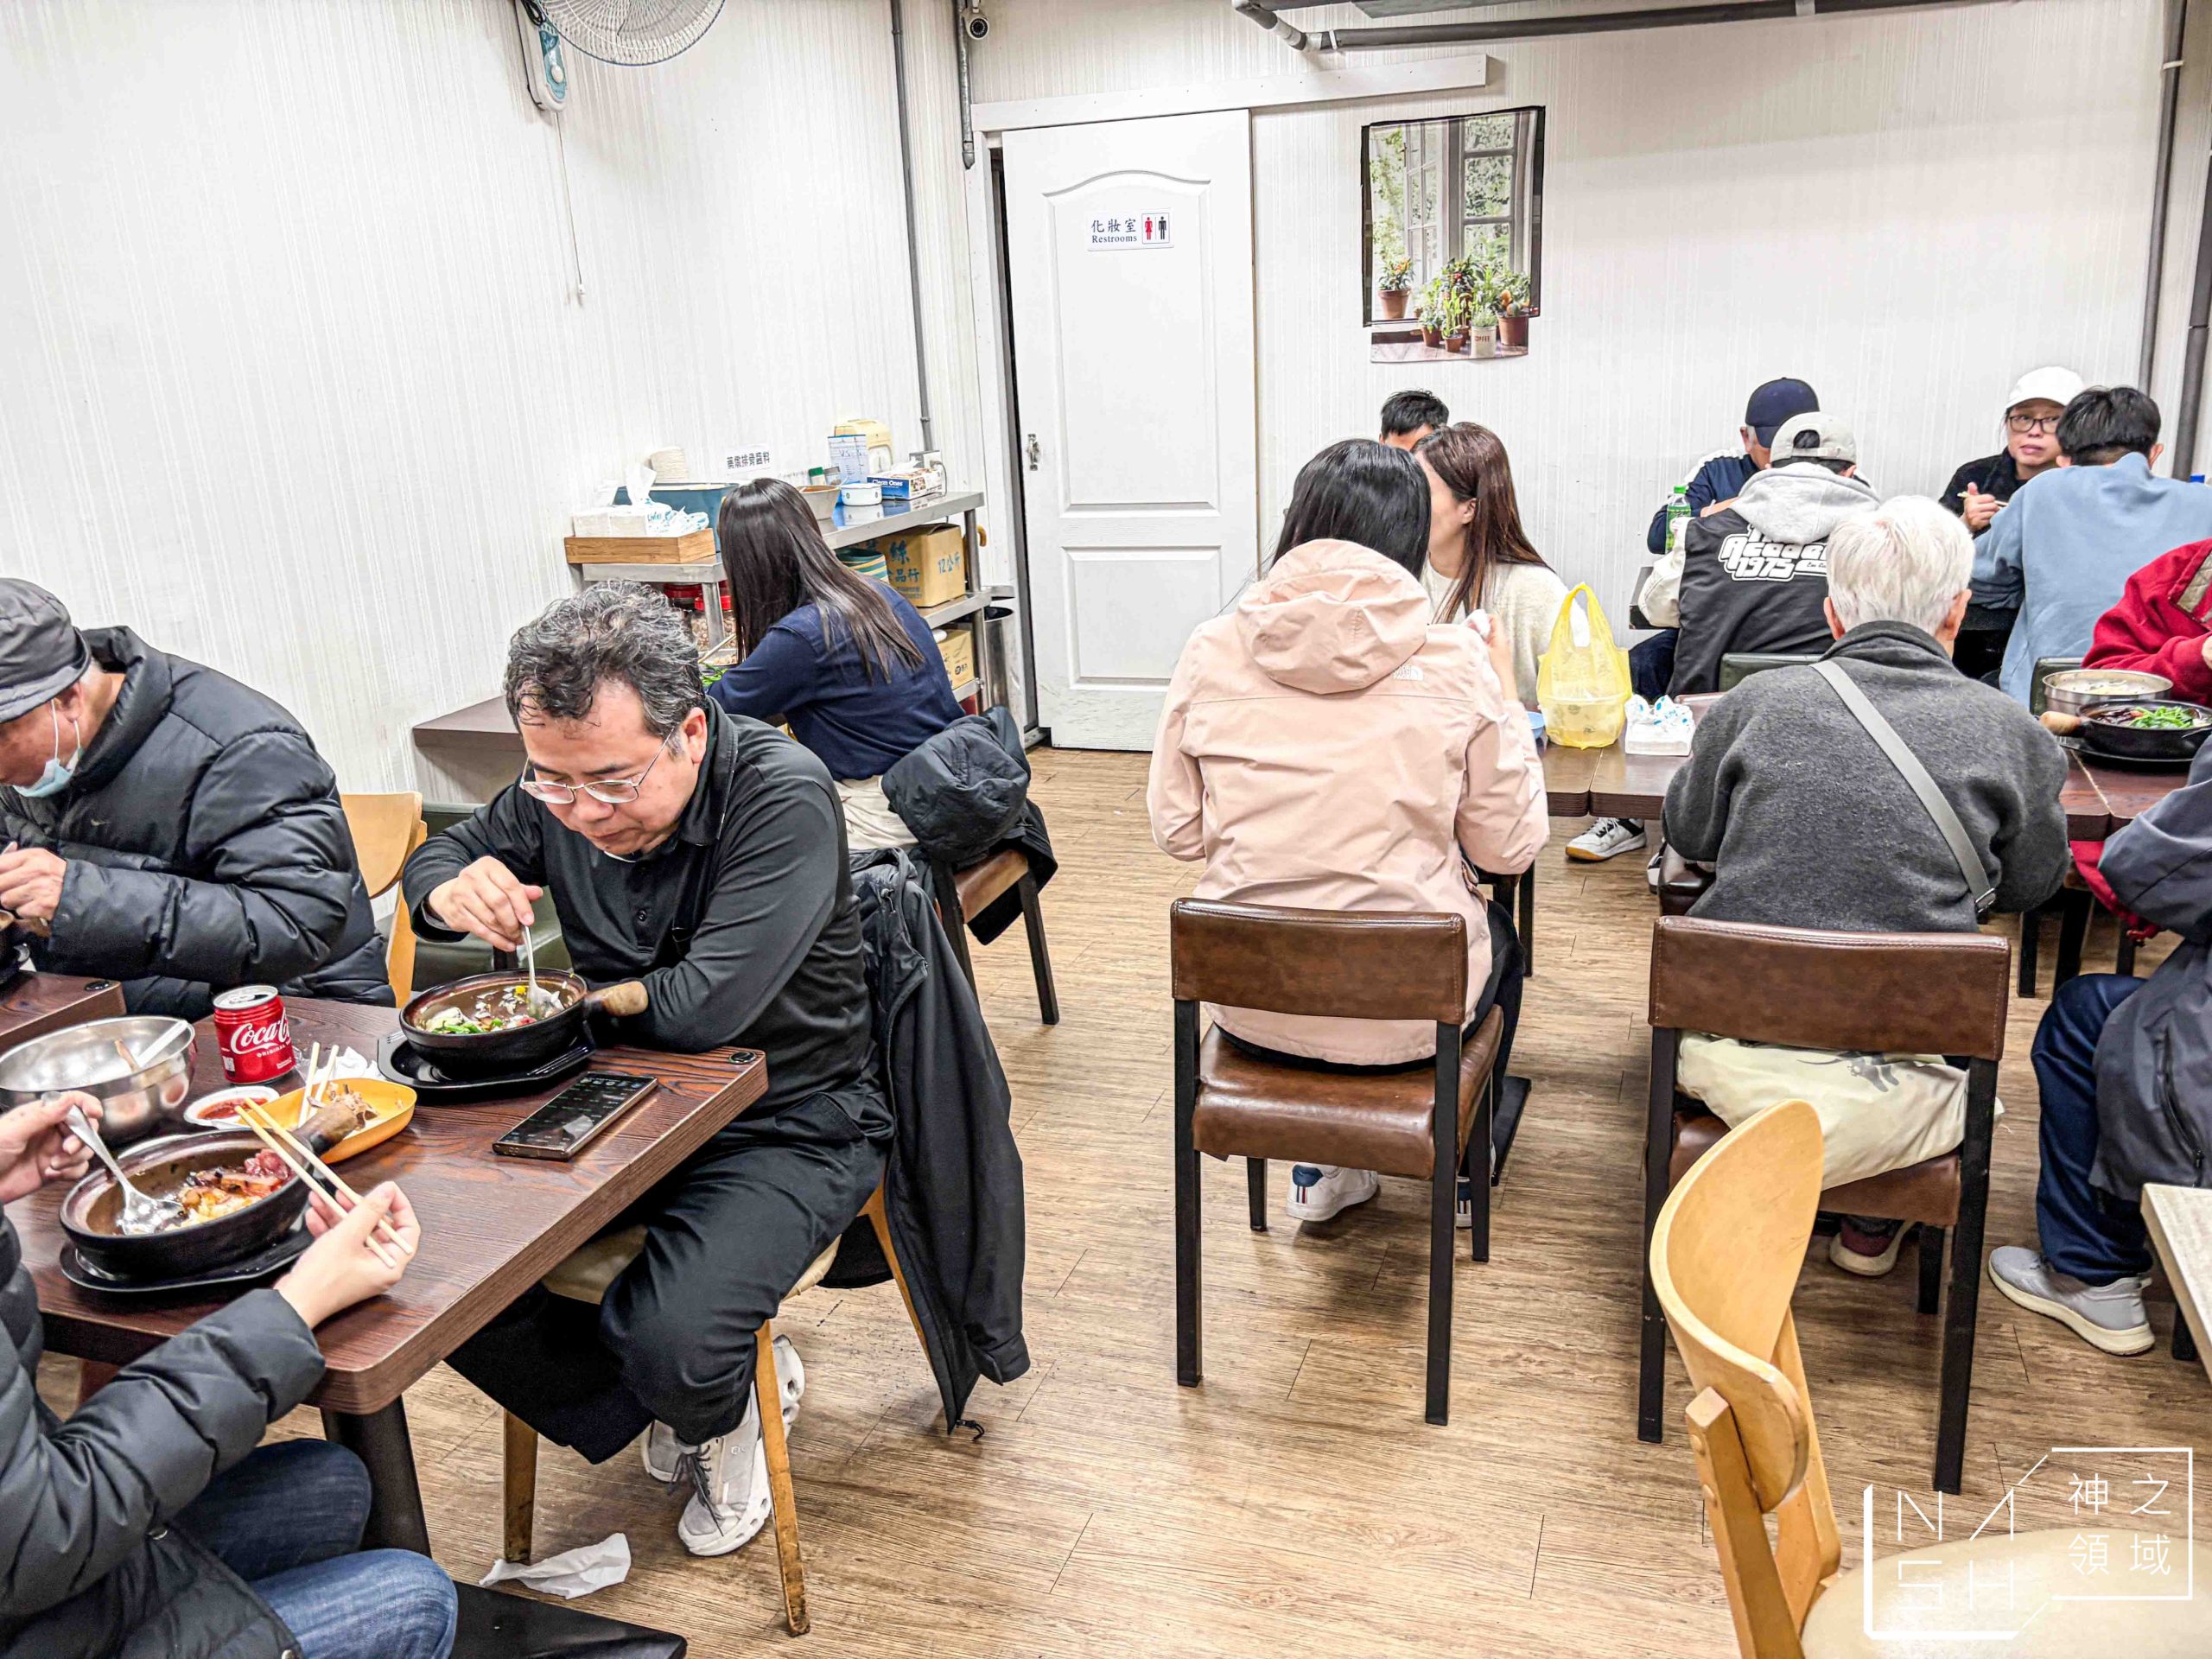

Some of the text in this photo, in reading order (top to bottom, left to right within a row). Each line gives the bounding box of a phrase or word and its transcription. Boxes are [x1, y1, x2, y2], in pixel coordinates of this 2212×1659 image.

[1091, 218, 1137, 232] 化妝室
[1734, 556, 1796, 579] 1975
